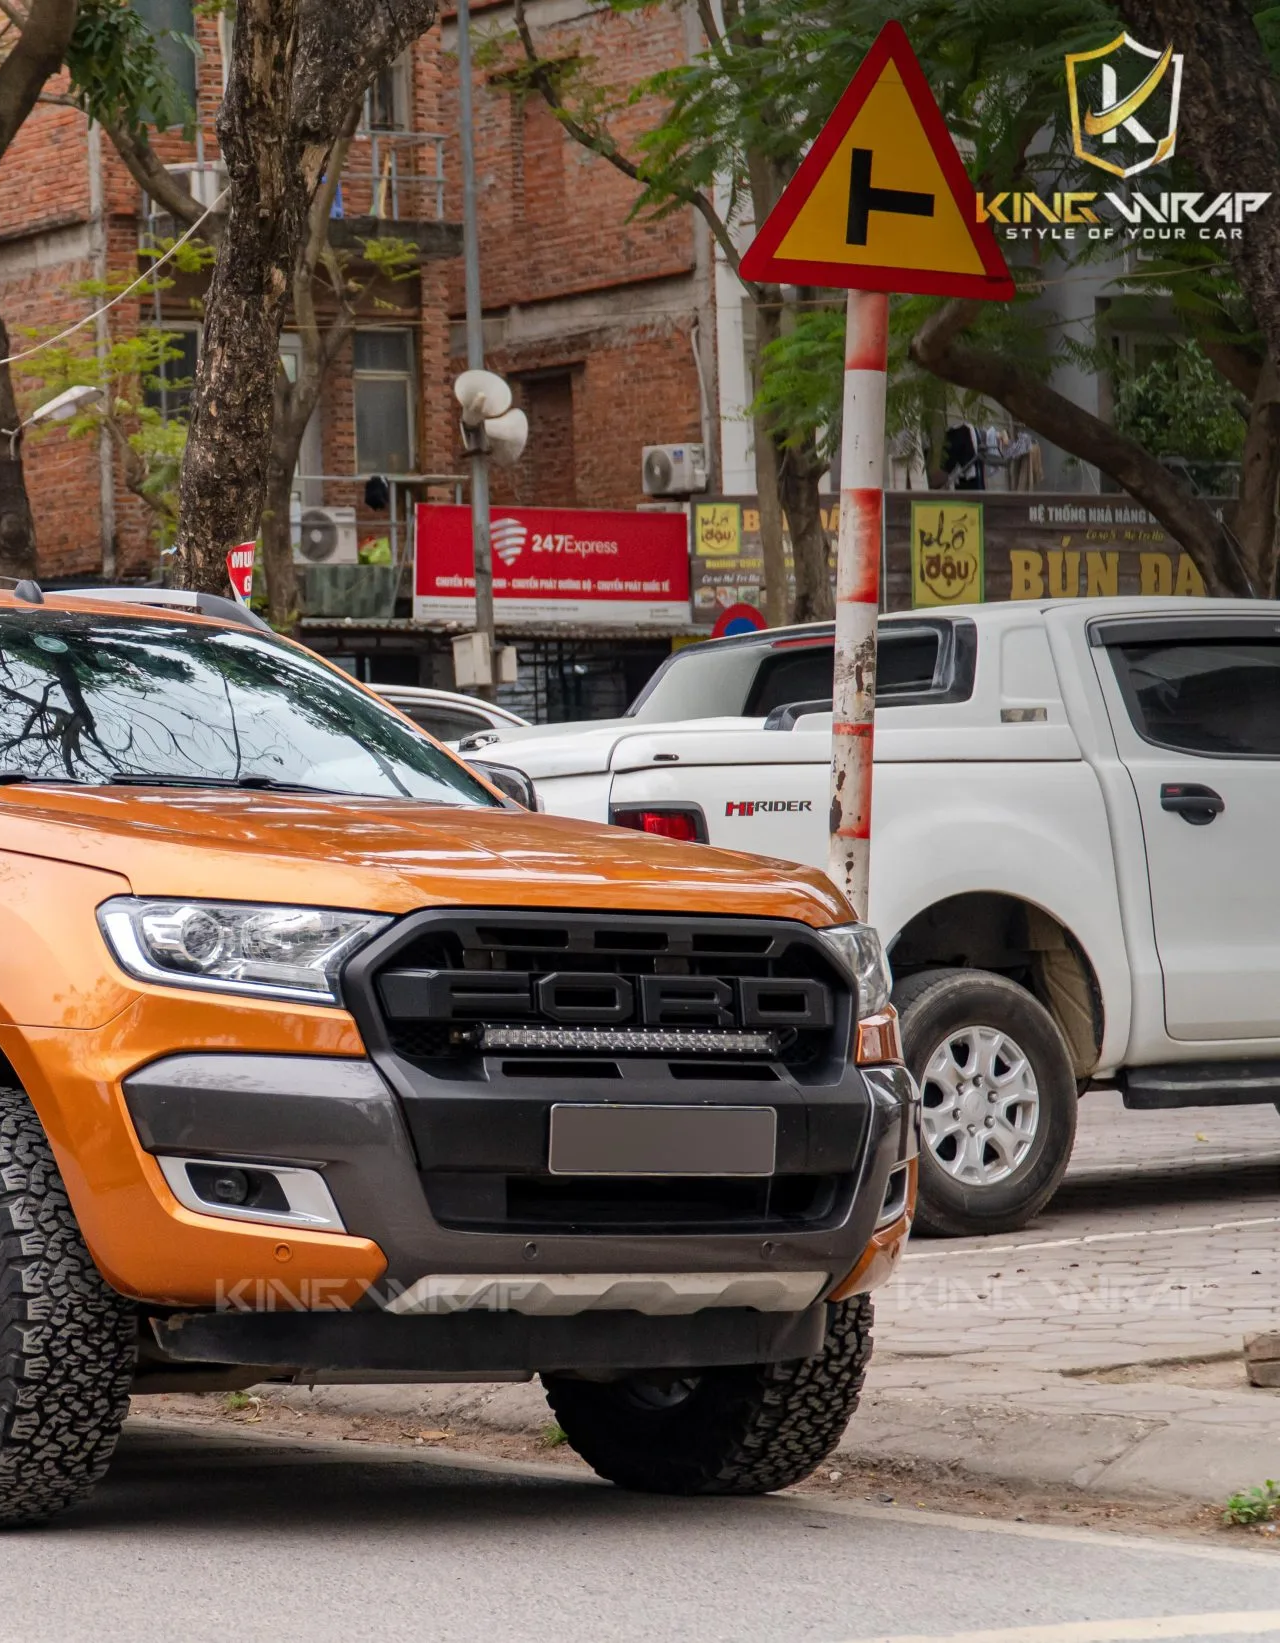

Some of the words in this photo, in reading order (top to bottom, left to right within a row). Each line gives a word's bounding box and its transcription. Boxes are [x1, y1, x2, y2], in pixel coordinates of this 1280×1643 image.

[919, 509, 970, 553] phố
[1029, 502, 1046, 524] HỆ
[1047, 499, 1086, 523] THỐNG
[1088, 504, 1113, 523] NHÀ
[1114, 504, 1146, 524] HÀNG
[531, 535, 618, 557] 247Express
[925, 553, 969, 590] đậu
[1010, 535, 1120, 598] BÚN
[379, 969, 834, 1028] FORD
